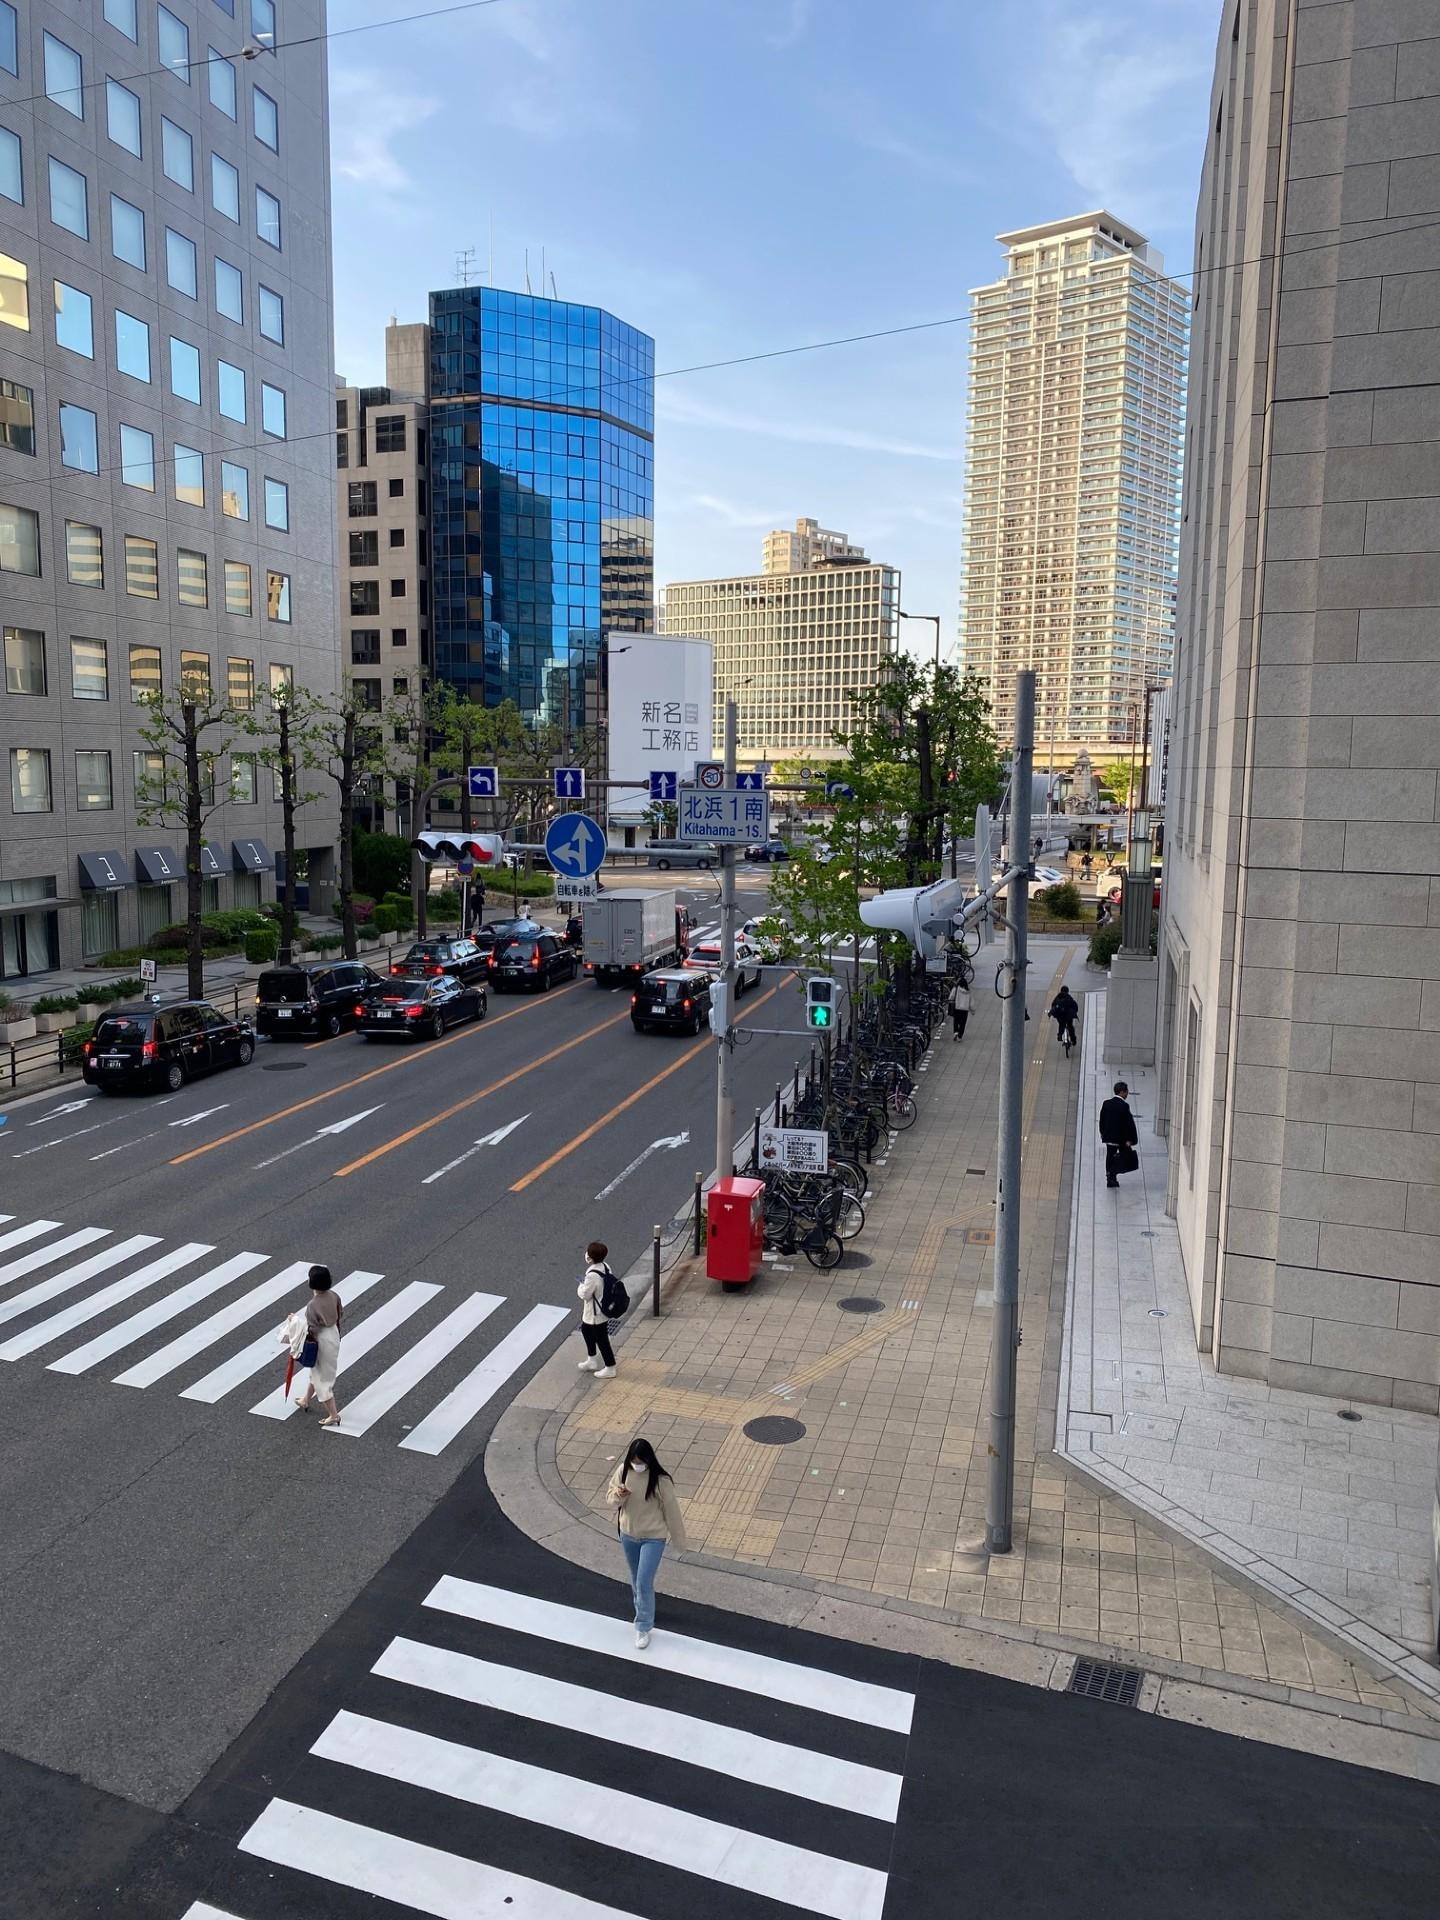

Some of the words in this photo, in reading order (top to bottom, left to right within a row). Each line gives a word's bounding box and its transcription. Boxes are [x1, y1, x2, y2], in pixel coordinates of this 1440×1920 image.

[642, 728, 699, 751] 工務店
[684, 795, 764, 821] 北浜1南
